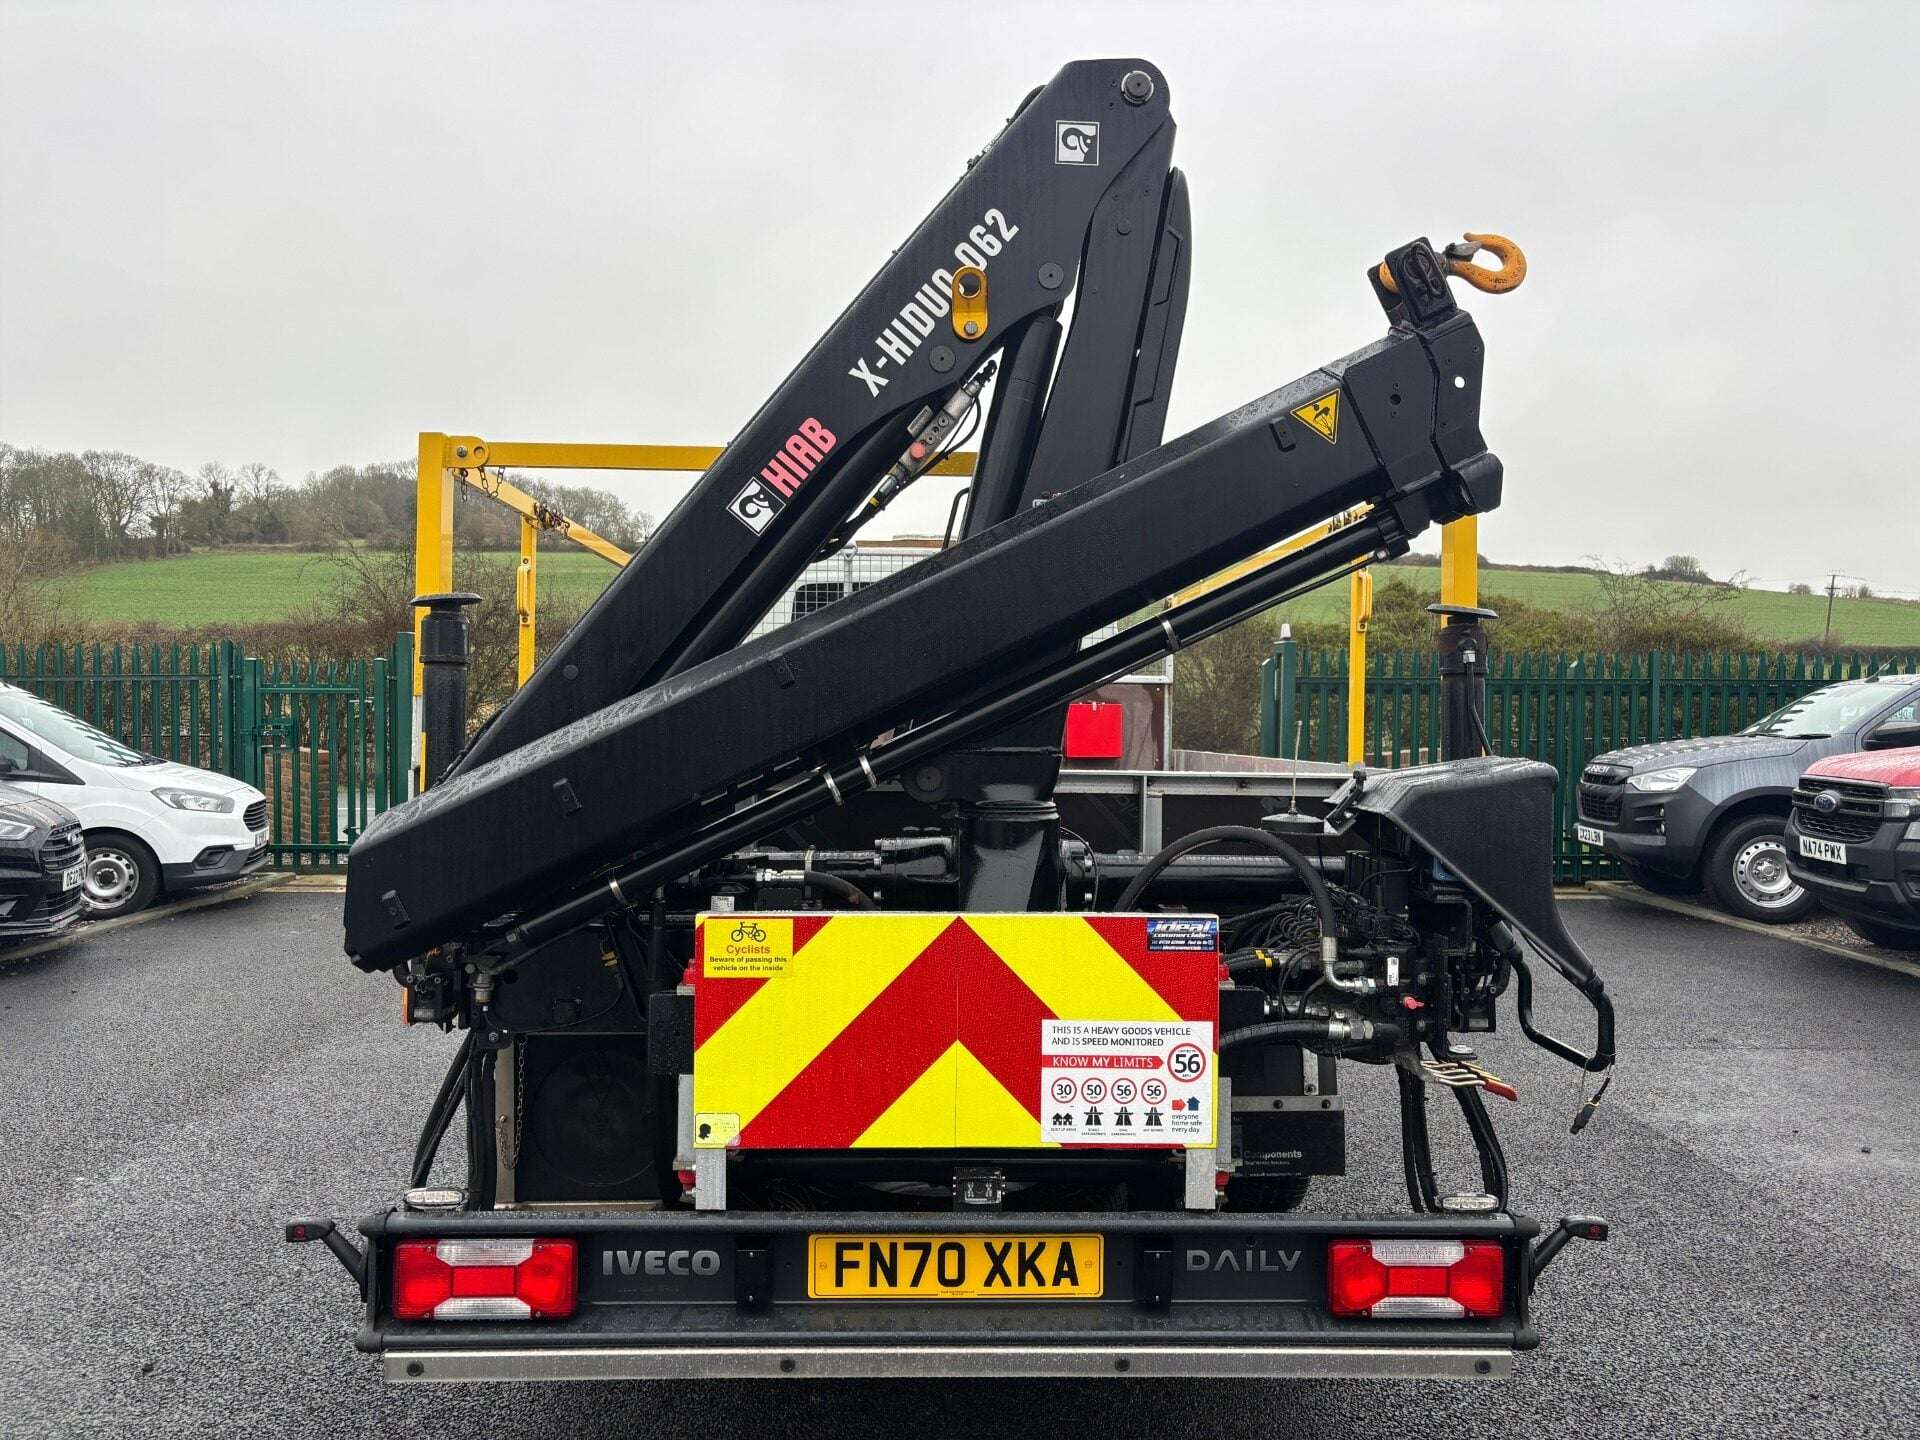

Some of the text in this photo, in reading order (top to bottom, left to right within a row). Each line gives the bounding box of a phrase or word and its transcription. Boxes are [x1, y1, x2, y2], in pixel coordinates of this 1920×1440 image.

[954, 208, 1019, 272] 062
[760, 416, 838, 498] HIAB
[1802, 836, 1842, 861] NA74 PWX
[726, 944, 771, 956] Cyclists
[745, 956, 773, 964] passing
[1052, 1026, 1191, 1036] THIS IS A HEAVY GOODS VEHICLE
[1052, 1037, 1164, 1047] AND IS SPEED MONITORED
[1053, 1056, 1154, 1068] KNOW MY LIMITS
[1174, 1053, 1200, 1074] 56
[1056, 1084, 1072, 1096] 30
[1086, 1084, 1102, 1096] 50
[1116, 1085, 1132, 1096] 56
[1146, 1085, 1162, 1097] 56
[1188, 1126, 1200, 1135] day
[602, 1249, 721, 1277] IVECO
[834, 1241, 1080, 1288] FN70 XKA
[1186, 1248, 1302, 1273] DAILY
